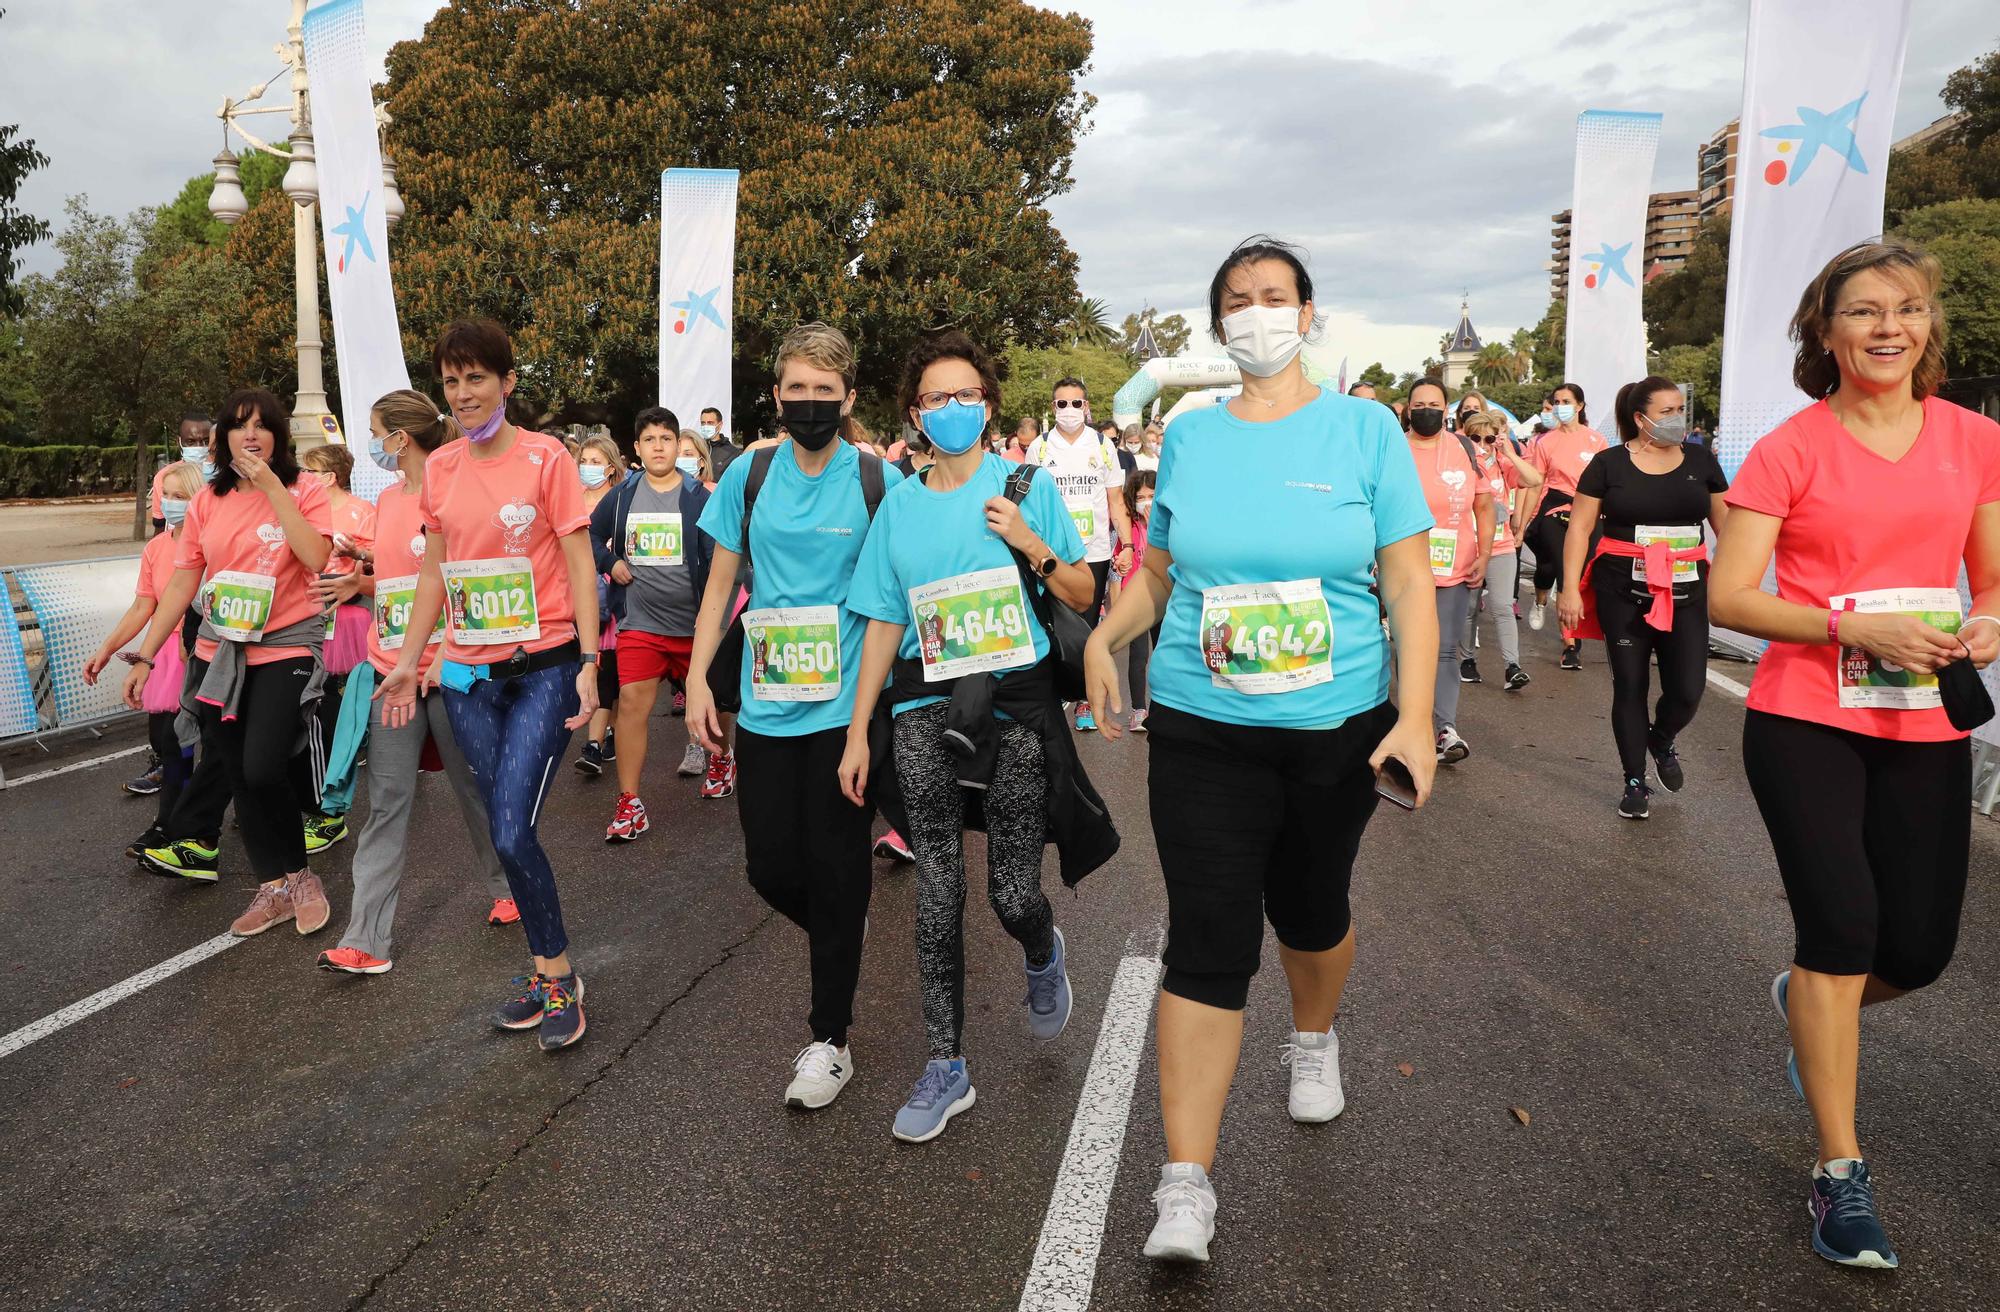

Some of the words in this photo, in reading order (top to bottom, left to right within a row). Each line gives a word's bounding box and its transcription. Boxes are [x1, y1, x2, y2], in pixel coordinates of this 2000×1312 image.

[1177, 361, 1200, 369] aecc
[1207, 364, 1226, 373] 900
[1056, 474, 1098, 486] mirates
[1069, 486, 1092, 495] BETTER
[504, 513, 532, 521] aecc
[640, 532, 676, 550] 6170
[470, 588, 528, 620] 6012
[218, 596, 262, 624] 6011
[946, 603, 1023, 646] 4649
[926, 640, 940, 650] MAR
[1232, 620, 1327, 661] 4642
[768, 641, 834, 673] 4650
[927, 649, 942, 658] CHA
[1209, 651, 1226, 660] MAR
[1210, 659, 1228, 668] CHA
[1847, 661, 1869, 670] MAR
[1847, 670, 1869, 680] CHA
[829, 1062, 843, 1080] N
